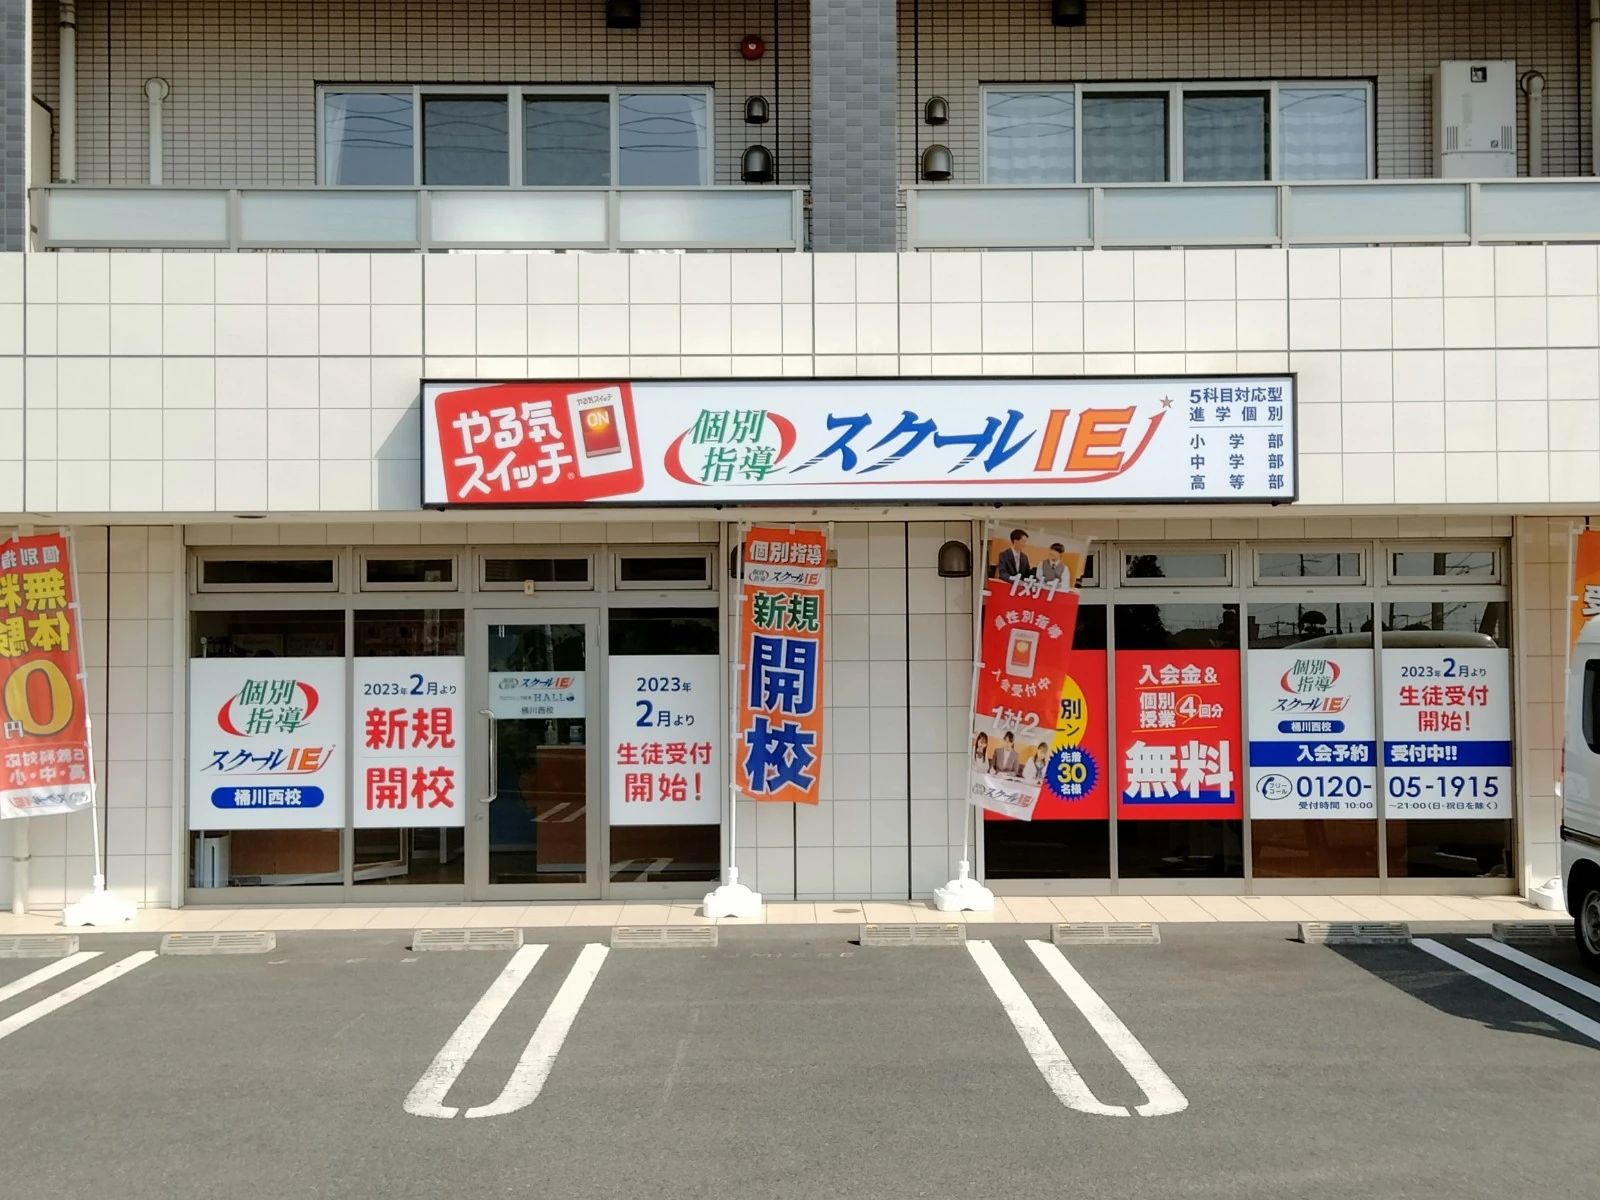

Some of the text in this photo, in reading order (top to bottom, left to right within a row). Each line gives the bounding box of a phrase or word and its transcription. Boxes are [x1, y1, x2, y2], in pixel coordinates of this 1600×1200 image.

[1190, 387, 1283, 404] 5科目対応型
[586, 411, 610, 428] ON
[1189, 406, 1283, 422] 進学個別
[452, 400, 562, 454] やる気
[691, 409, 767, 444] 個別
[789, 406, 1137, 475] スクールIE
[1190, 433, 1283, 449] 小学部
[454, 442, 573, 499] スイッチ
[701, 446, 776, 482] 指導
[1191, 454, 1284, 470] 中学部
[1190, 475, 1285, 490] 高等部
[750, 540, 822, 565] 個別指導
[1009, 573, 1060, 602] 1対1
[752, 591, 820, 632] 新規
[1138, 664, 1218, 685] 入会金&
[1293, 659, 1327, 675] 個別
[1400, 658, 1488, 678] 2023年2月より
[236, 679, 298, 706] 個別
[363, 674, 457, 696] 2023年2月より
[636, 677, 692, 692] 2023年
[1297, 676, 1333, 693] 指導
[1400, 685, 1489, 706] 生徒受付
[1139, 692, 1175, 709] 個別
[246, 707, 303, 734] 指導
[635, 700, 695, 727] 2月より
[744, 634, 820, 794] 開校
[992, 705, 1040, 737] 1対2
[1139, 710, 1176, 728] 授業
[1418, 711, 1470, 732] 開始!
[365, 708, 456, 750] 新規
[200, 747, 323, 772] スクールIE
[617, 742, 712, 765] 生徒受付
[1297, 744, 1369, 763] 入会予約
[1391, 744, 1457, 763] 受付中!!
[1057, 763, 1087, 783] 30
[1125, 740, 1234, 799] 無料
[234, 788, 302, 806] 桶川西校
[366, 766, 455, 810] 開校
[625, 773, 702, 802] 開始!
[1297, 776, 1372, 798] 0120-
[1389, 776, 1499, 798] 05-1915
[1299, 802, 1340, 810] 受付時間
